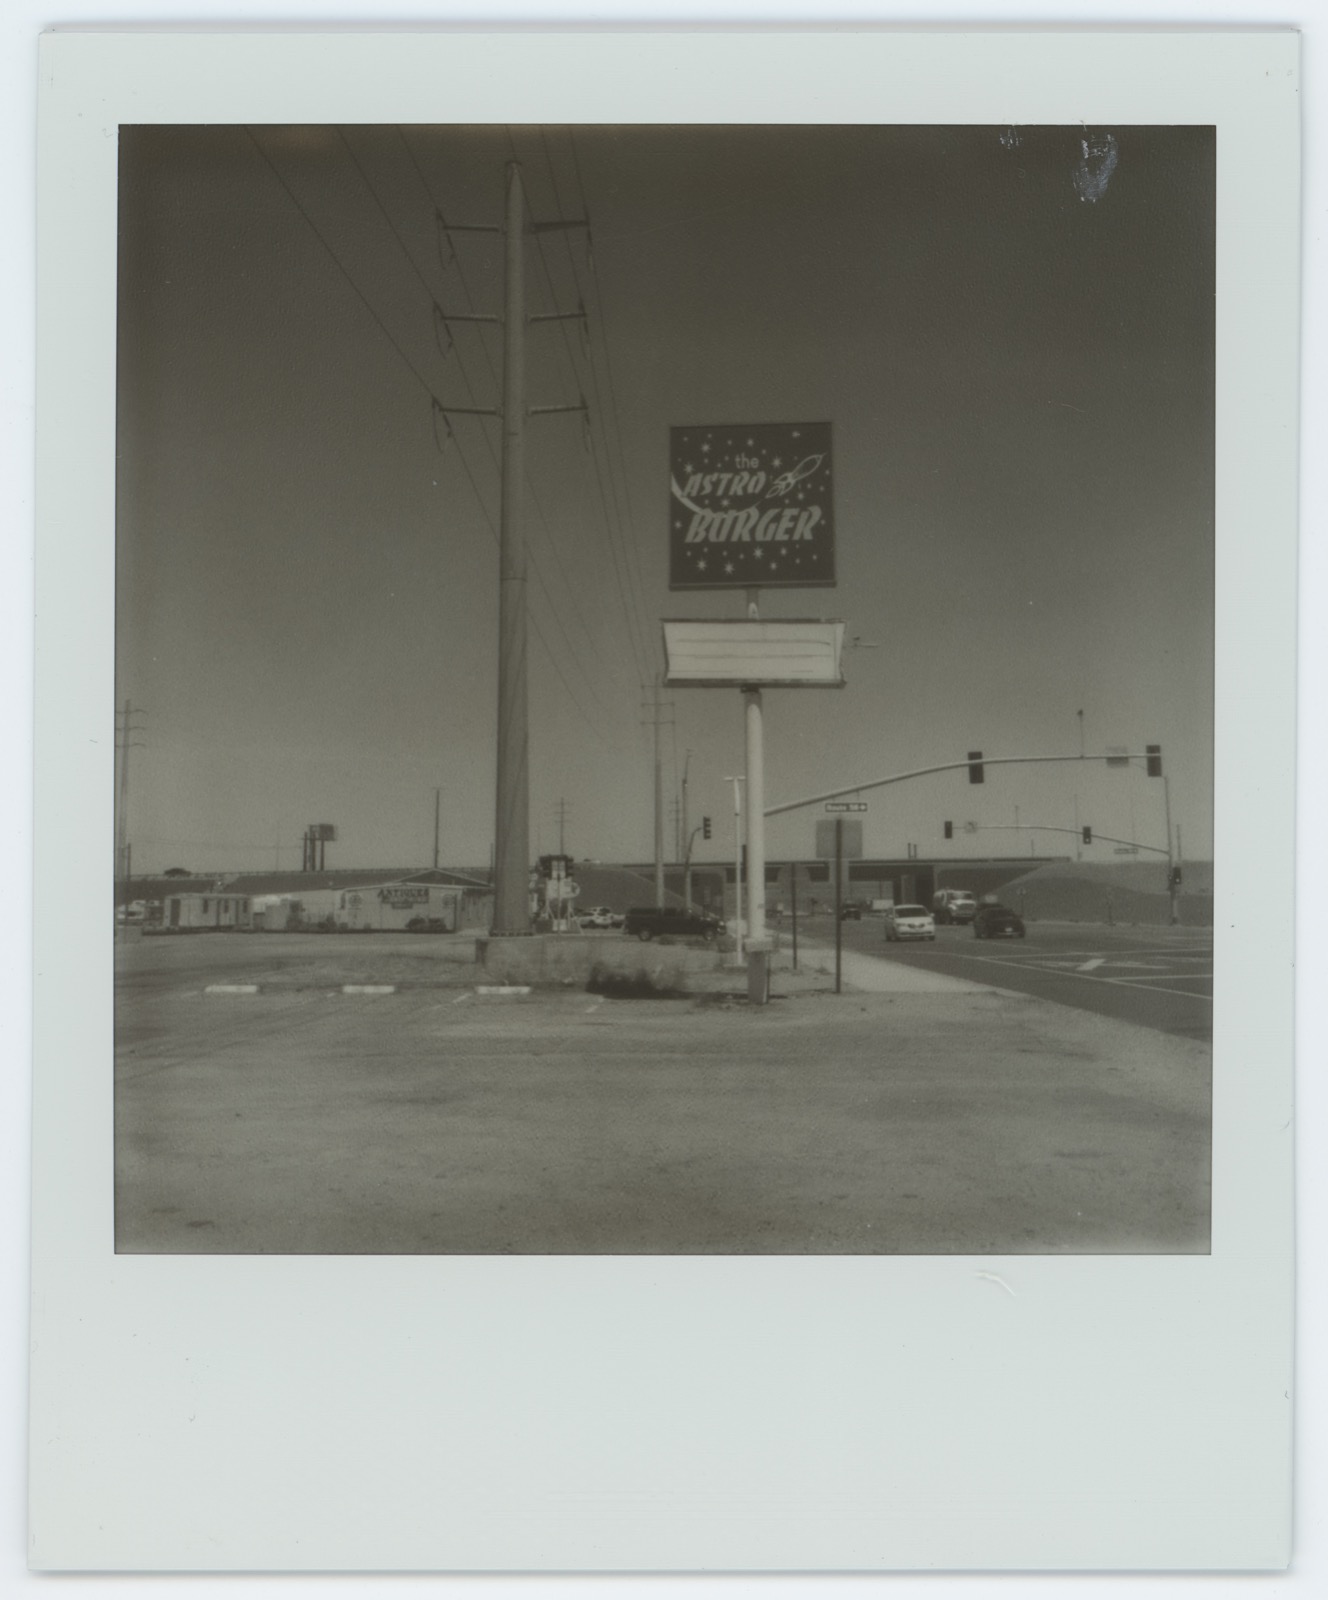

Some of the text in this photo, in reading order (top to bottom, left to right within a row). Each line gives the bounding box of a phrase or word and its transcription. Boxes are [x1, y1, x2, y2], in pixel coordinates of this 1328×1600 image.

[735, 453, 759, 469] the
[681, 471, 767, 497] ASTRO
[684, 505, 822, 543] BURGER
